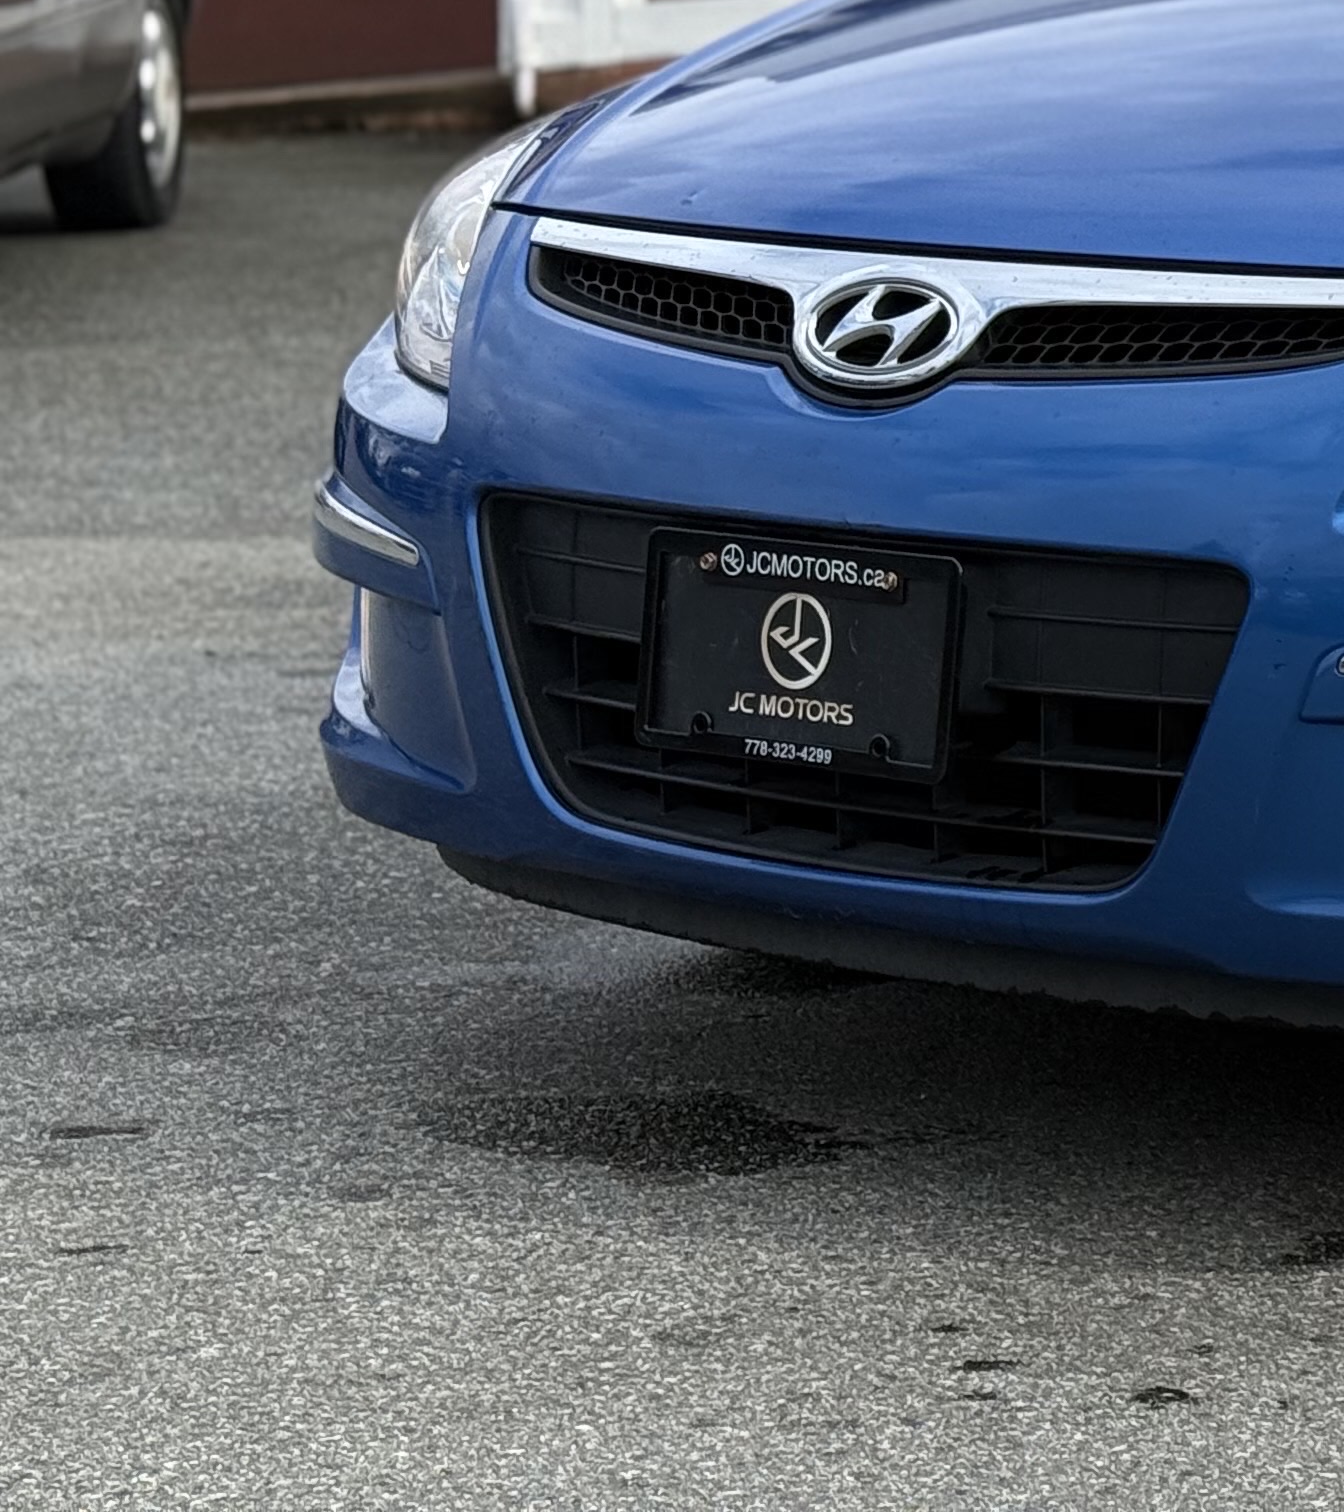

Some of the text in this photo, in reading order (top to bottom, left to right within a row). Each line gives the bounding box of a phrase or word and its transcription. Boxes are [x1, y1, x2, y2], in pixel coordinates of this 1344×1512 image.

[728, 690, 855, 726] JC MOTORS
[743, 737, 833, 765] 778-323-4299
